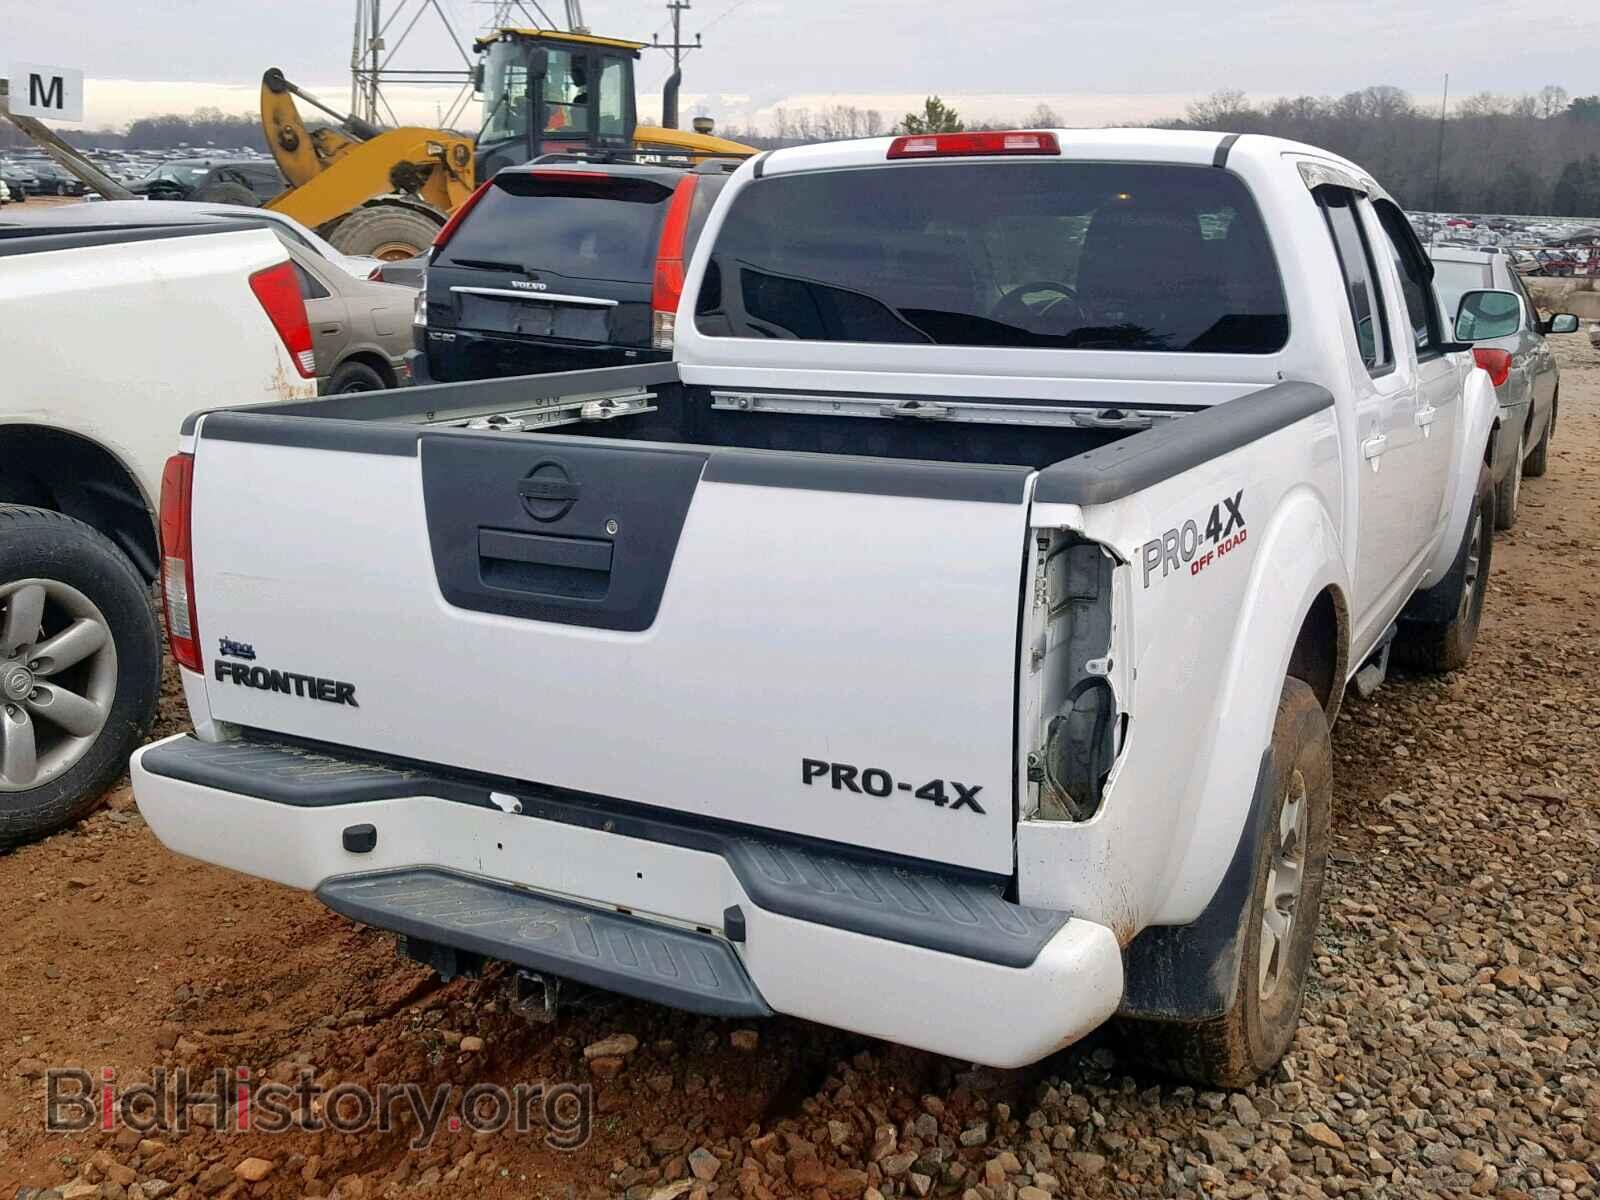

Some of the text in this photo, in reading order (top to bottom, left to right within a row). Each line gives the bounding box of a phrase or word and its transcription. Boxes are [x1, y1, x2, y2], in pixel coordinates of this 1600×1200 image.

[29, 72, 64, 110] M
[511, 280, 547, 291] VOLVO
[1142, 488, 1246, 589] PRO-4X
[1190, 529, 1247, 576] OFF ROAD
[214, 659, 360, 707] FRONTIER
[802, 757, 987, 815] PRO-4X
